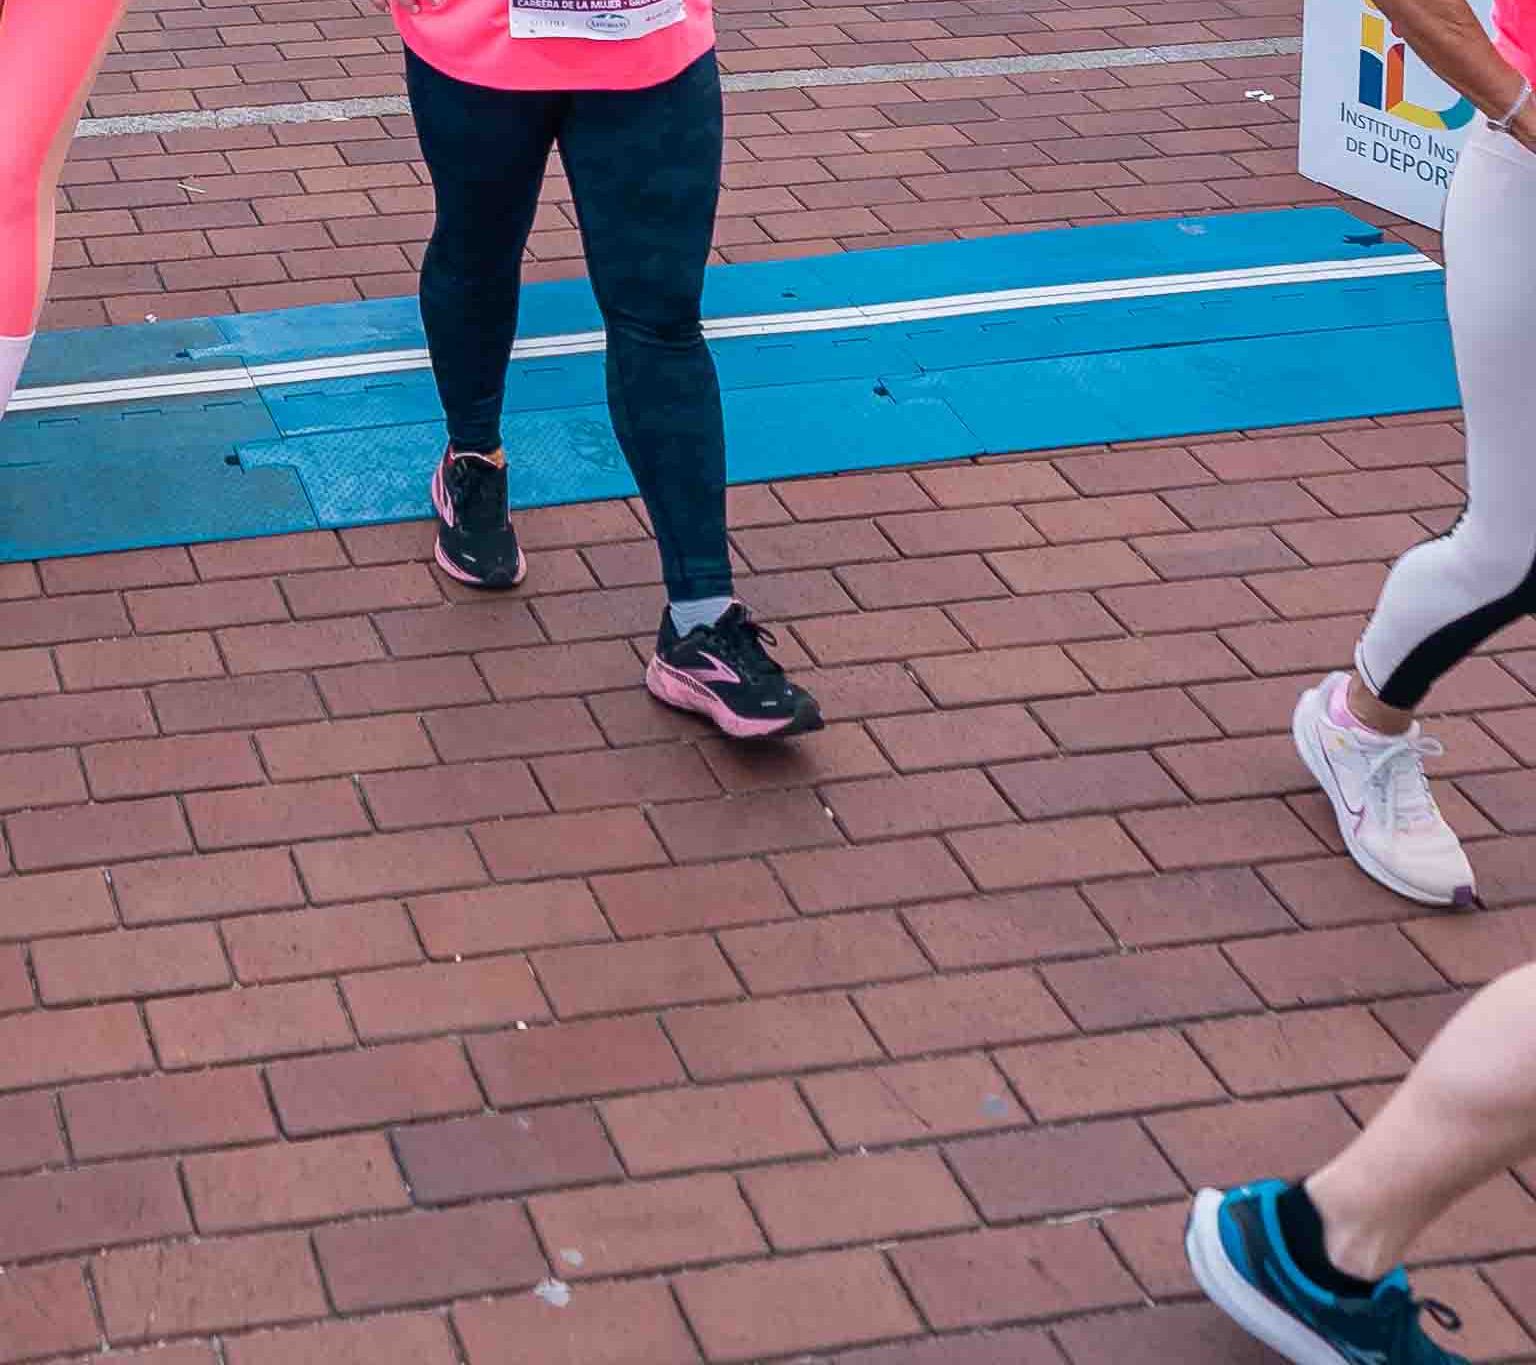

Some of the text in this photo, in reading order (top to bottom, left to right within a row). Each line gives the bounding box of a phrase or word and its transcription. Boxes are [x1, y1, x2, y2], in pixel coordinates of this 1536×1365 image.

[562, 0, 574, 10] DE
[576, 0, 588, 10] LA
[1341, 102, 1422, 150] INSTITUTO
[1346, 137, 1454, 190] DE DEPOR
